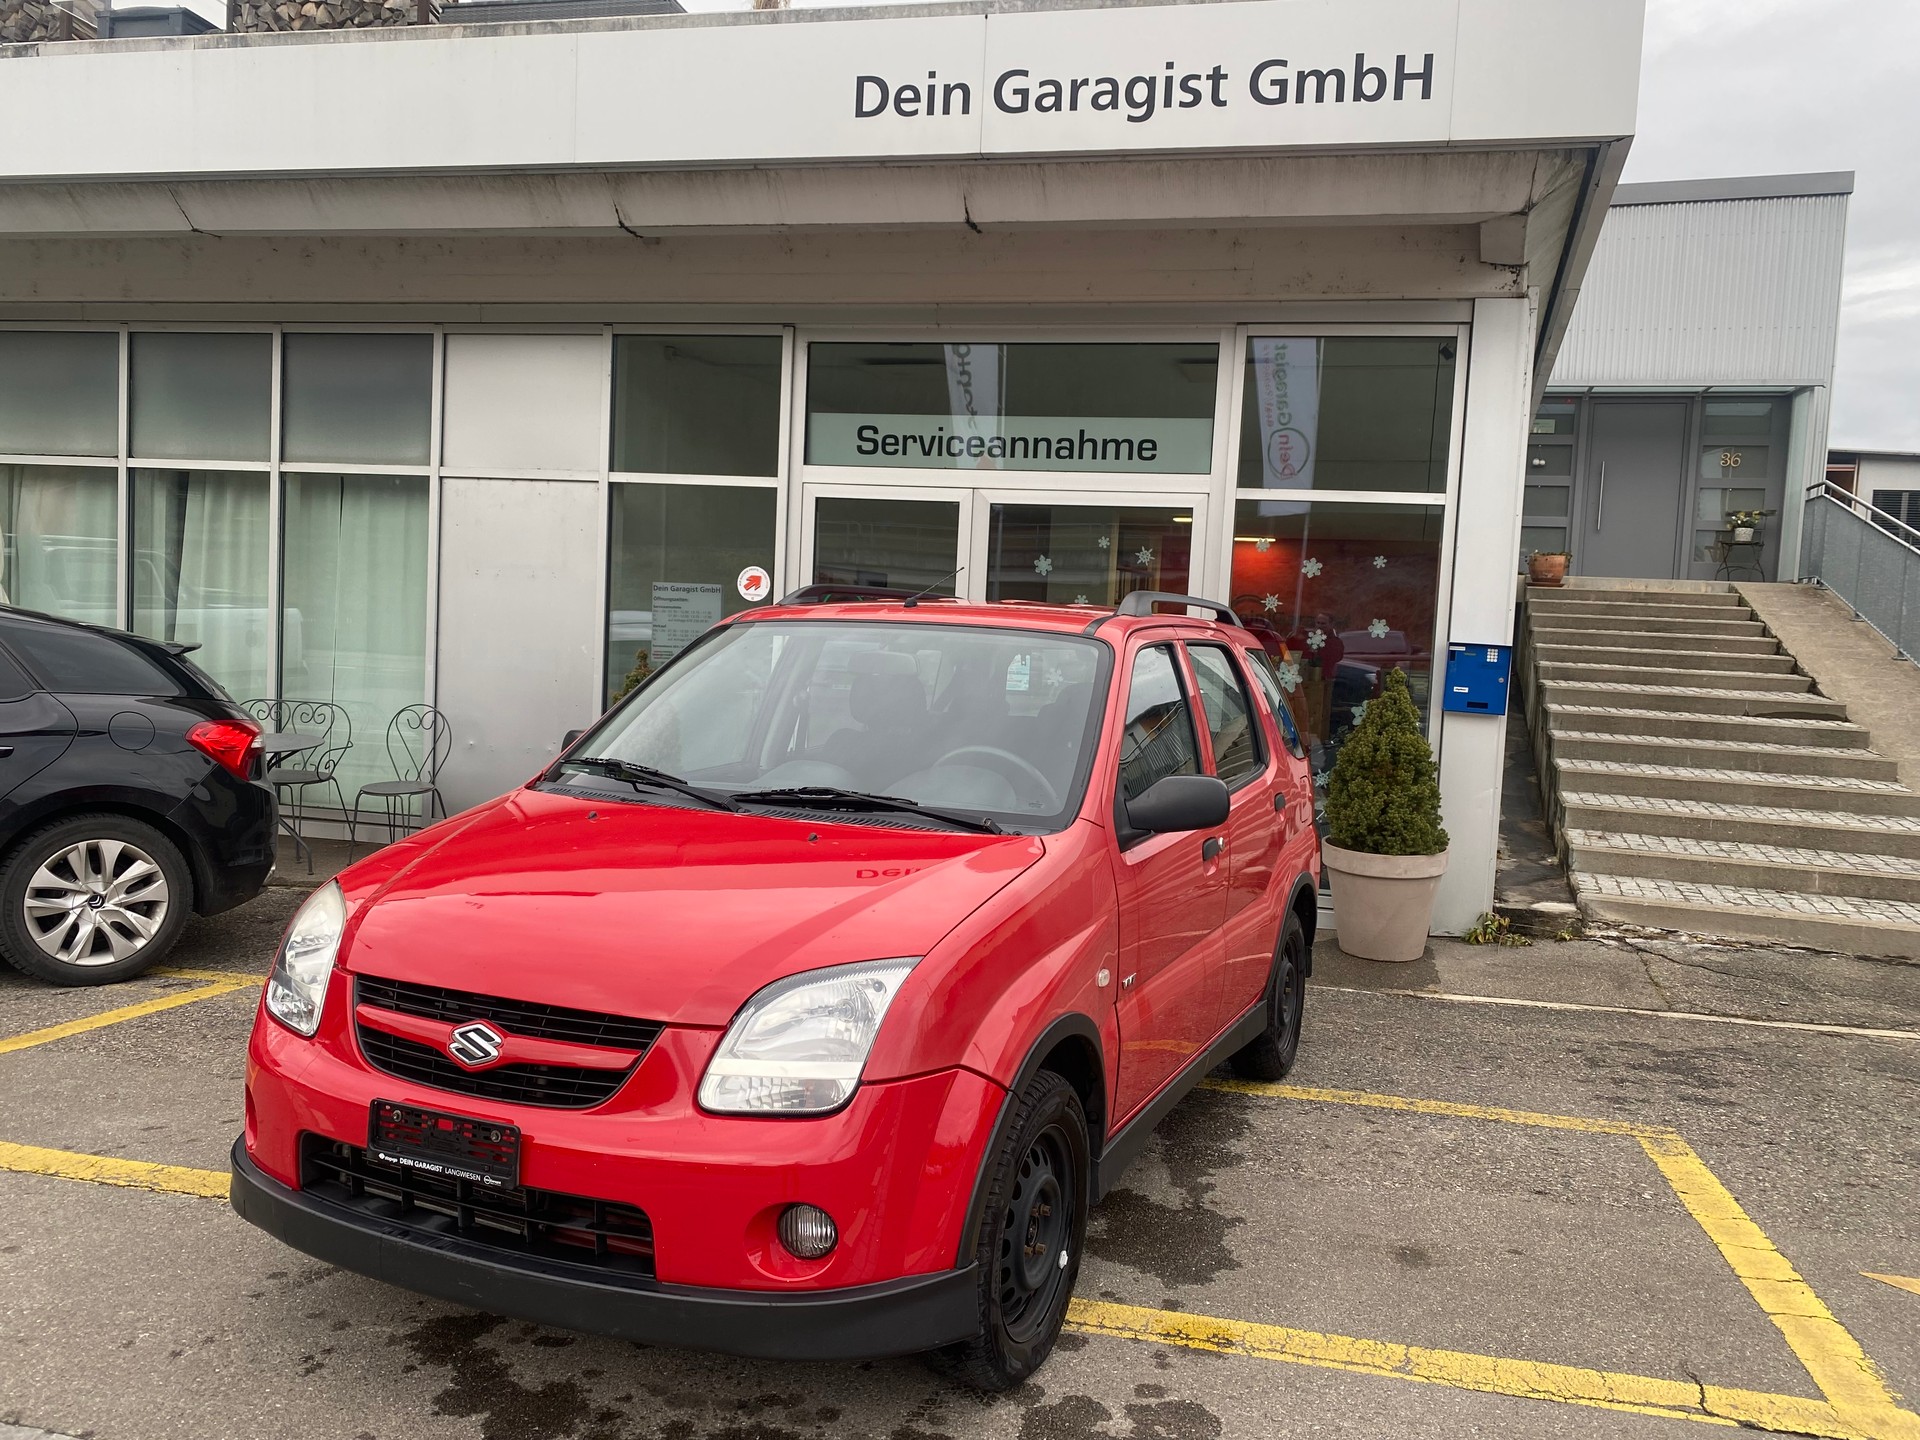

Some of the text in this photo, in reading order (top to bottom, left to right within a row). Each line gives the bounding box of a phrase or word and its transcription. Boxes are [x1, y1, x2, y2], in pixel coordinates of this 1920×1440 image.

[854, 53, 1435, 123] Dein Garagist GmbH
[856, 425, 1158, 461] Serviceannahme
[1720, 452, 1742, 467] 36
[653, 584, 721, 594] Dein Garagist GmbH
[400, 1158, 413, 1167] DEIN
[414, 1160, 443, 1173] GARAGIST
[445, 1168, 481, 1181] LANGWIESEN
